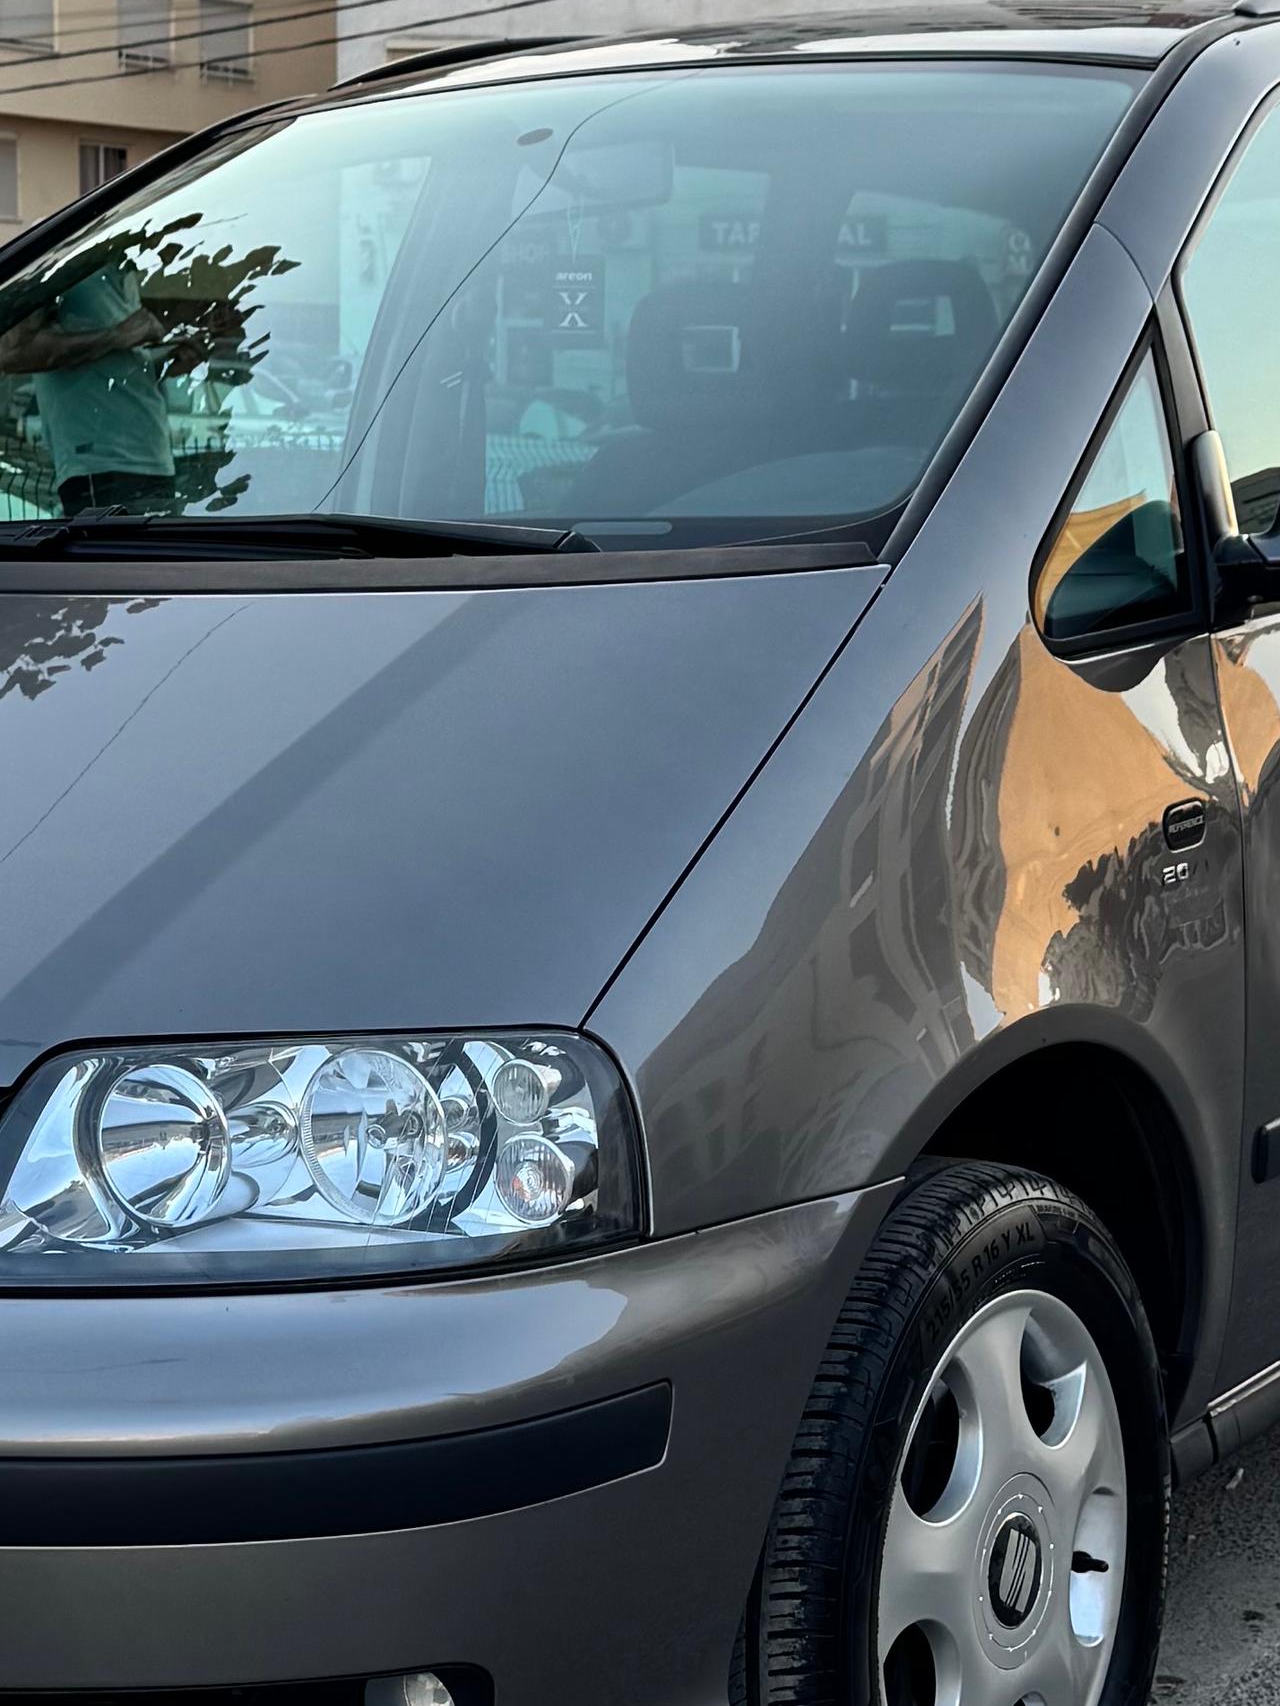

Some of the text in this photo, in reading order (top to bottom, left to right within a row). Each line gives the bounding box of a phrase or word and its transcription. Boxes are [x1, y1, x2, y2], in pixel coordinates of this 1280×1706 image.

[925, 1269, 971, 1342] 215/55
[970, 1254, 984, 1278] R
[983, 1239, 1000, 1264] 16
[1001, 1229, 1011, 1250] Y
[1015, 1222, 1036, 1246] XL
